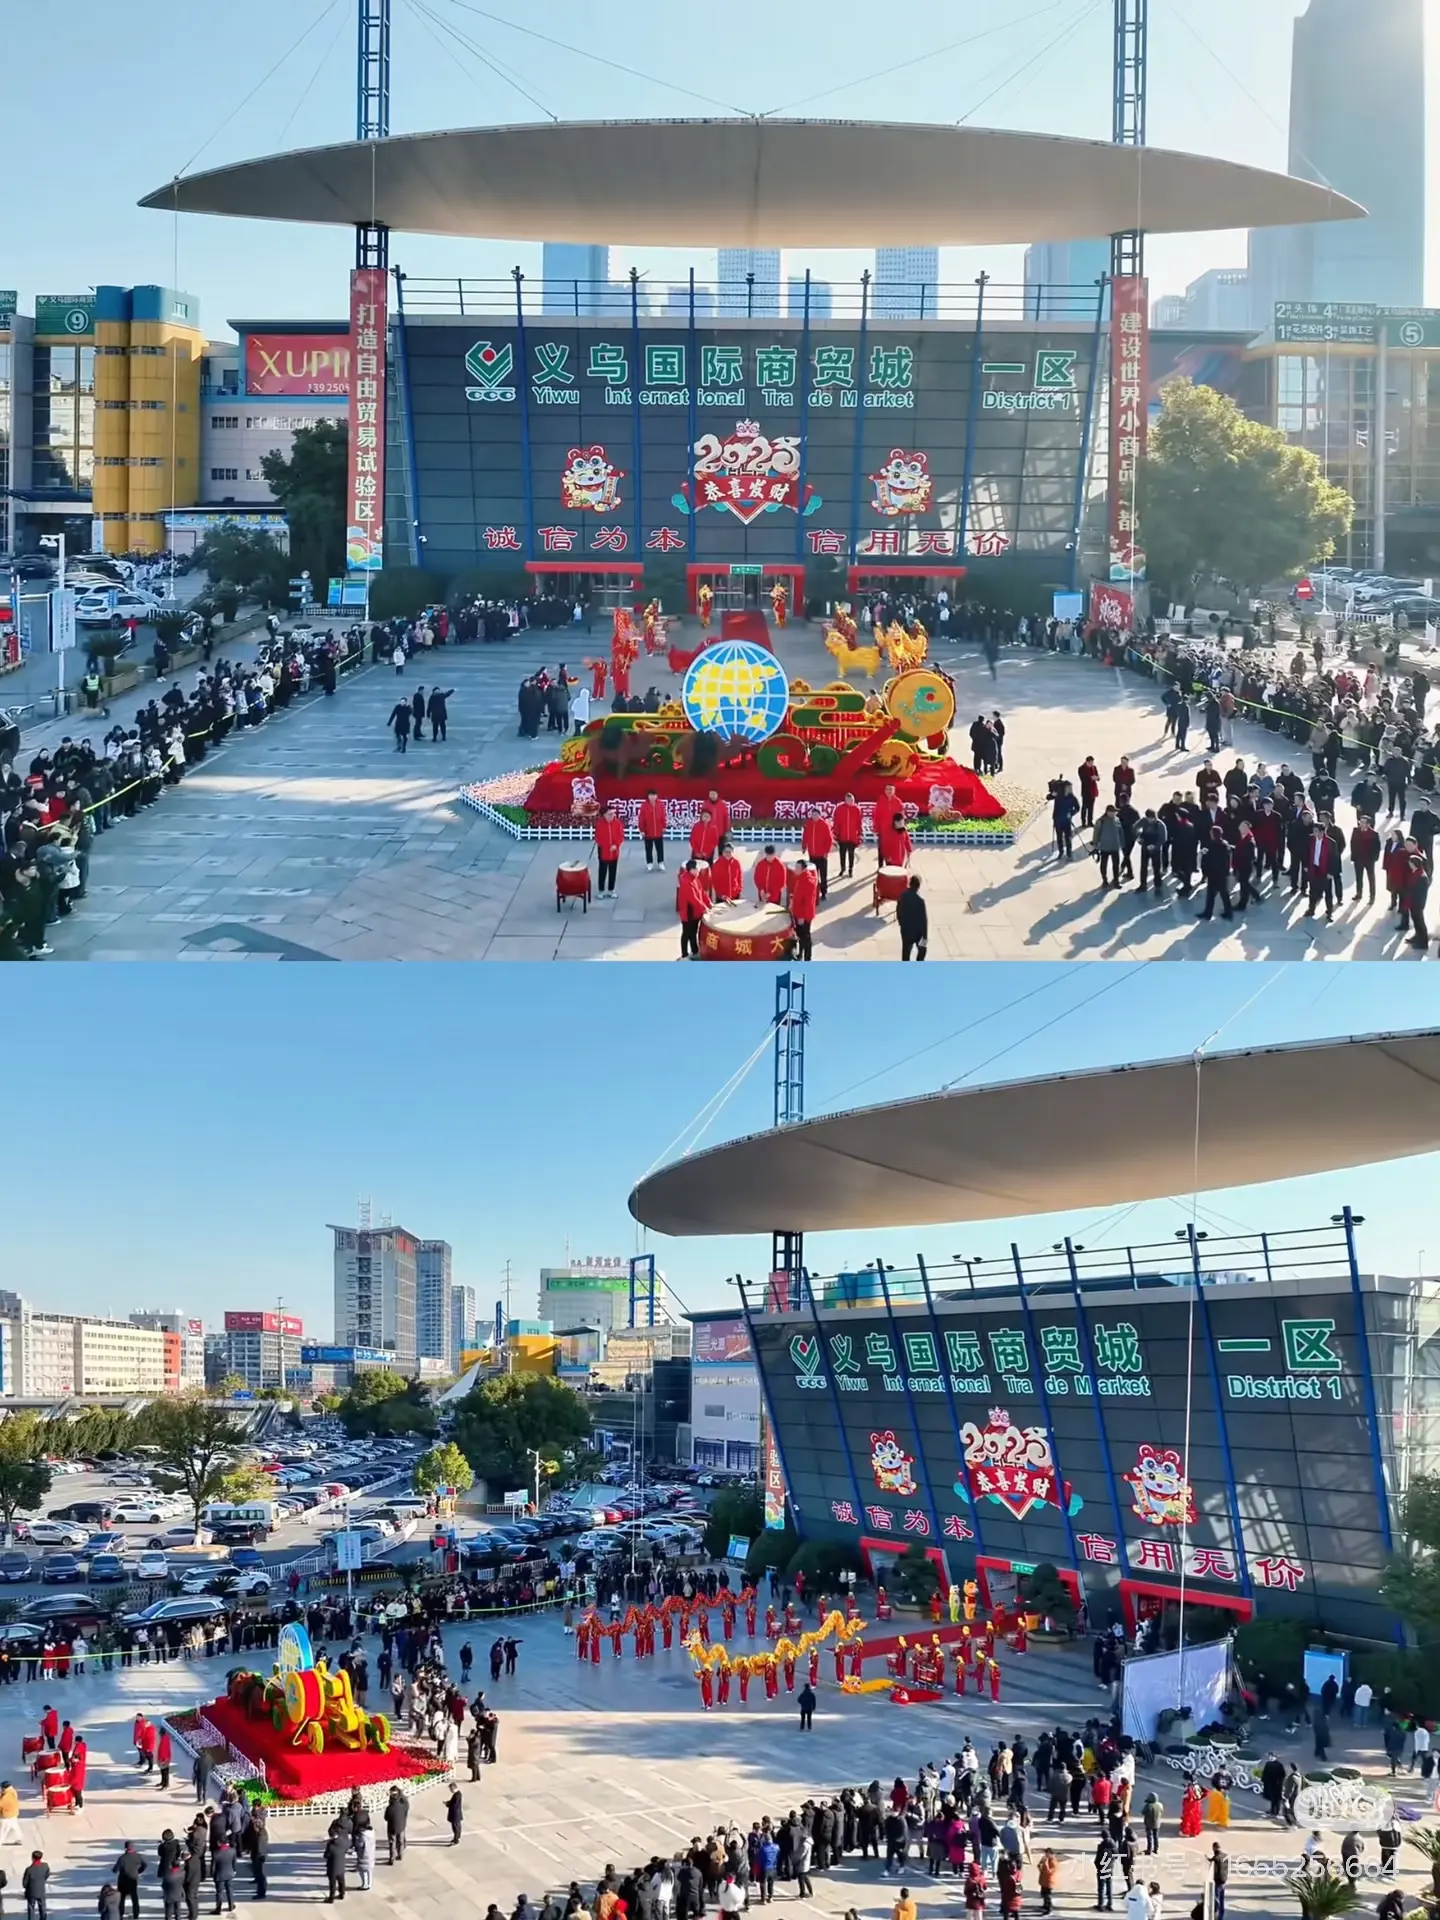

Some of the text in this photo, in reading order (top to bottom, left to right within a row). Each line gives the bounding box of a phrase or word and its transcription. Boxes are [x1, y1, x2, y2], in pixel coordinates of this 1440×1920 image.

[1276, 303, 1286, 318] 2
[1323, 303, 1333, 318] 4
[1324, 324, 1333, 340] 3
[531, 342, 1077, 388] 义乌国际商贸城 一区
[531, 386, 580, 404] Yiwu
[982, 390, 1055, 410] District
[1056, 391, 1070, 410] 1
[354, 303, 379, 522] 打造自由贸易试验区
[693, 433, 802, 474] 2025
[703, 477, 790, 502] 恭喜发财
[483, 525, 686, 552] 诚信为本
[806, 529, 1011, 557] 信用无价
[829, 1318, 1342, 1373] 义乌国际商贸城 一区
[835, 1374, 869, 1392] Yiwu
[1227, 1375, 1322, 1399] District
[1326, 1375, 1342, 1400] 1
[959, 1421, 1054, 1468] 2025
[976, 1470, 1051, 1498] 恭喜发财
[831, 1501, 975, 1541] 诚信为本
[1076, 1533, 1305, 1592] 信用无价
